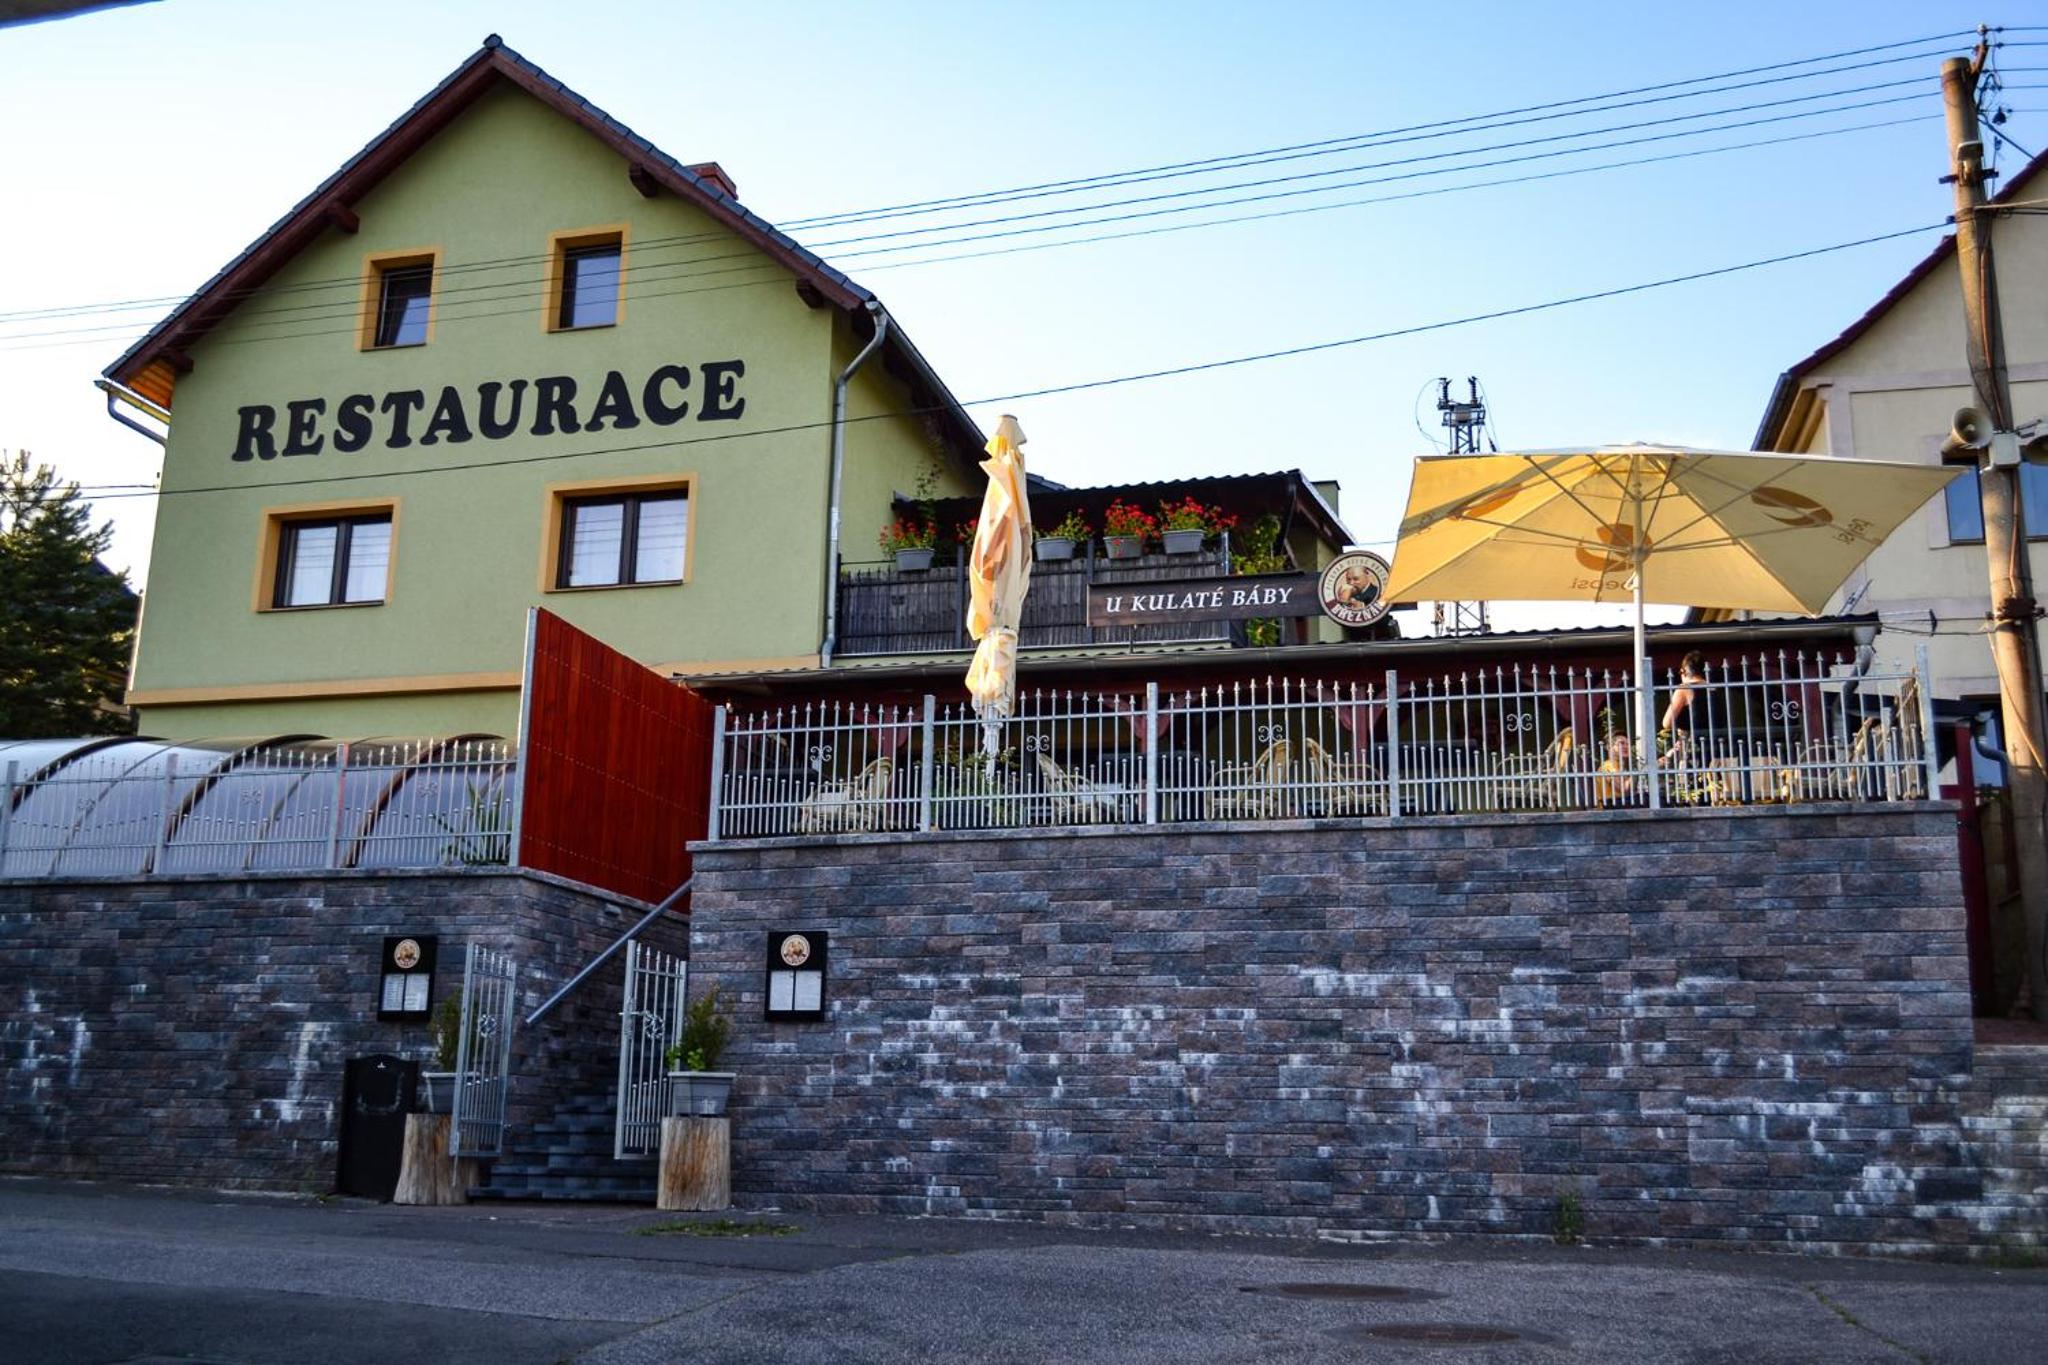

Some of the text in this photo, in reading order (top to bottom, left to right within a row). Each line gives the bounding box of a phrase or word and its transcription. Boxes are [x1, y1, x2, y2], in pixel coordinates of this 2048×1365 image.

[231, 359, 746, 462] RESTAURACE
[1106, 584, 1293, 613] U KULATÉ BÁBY
